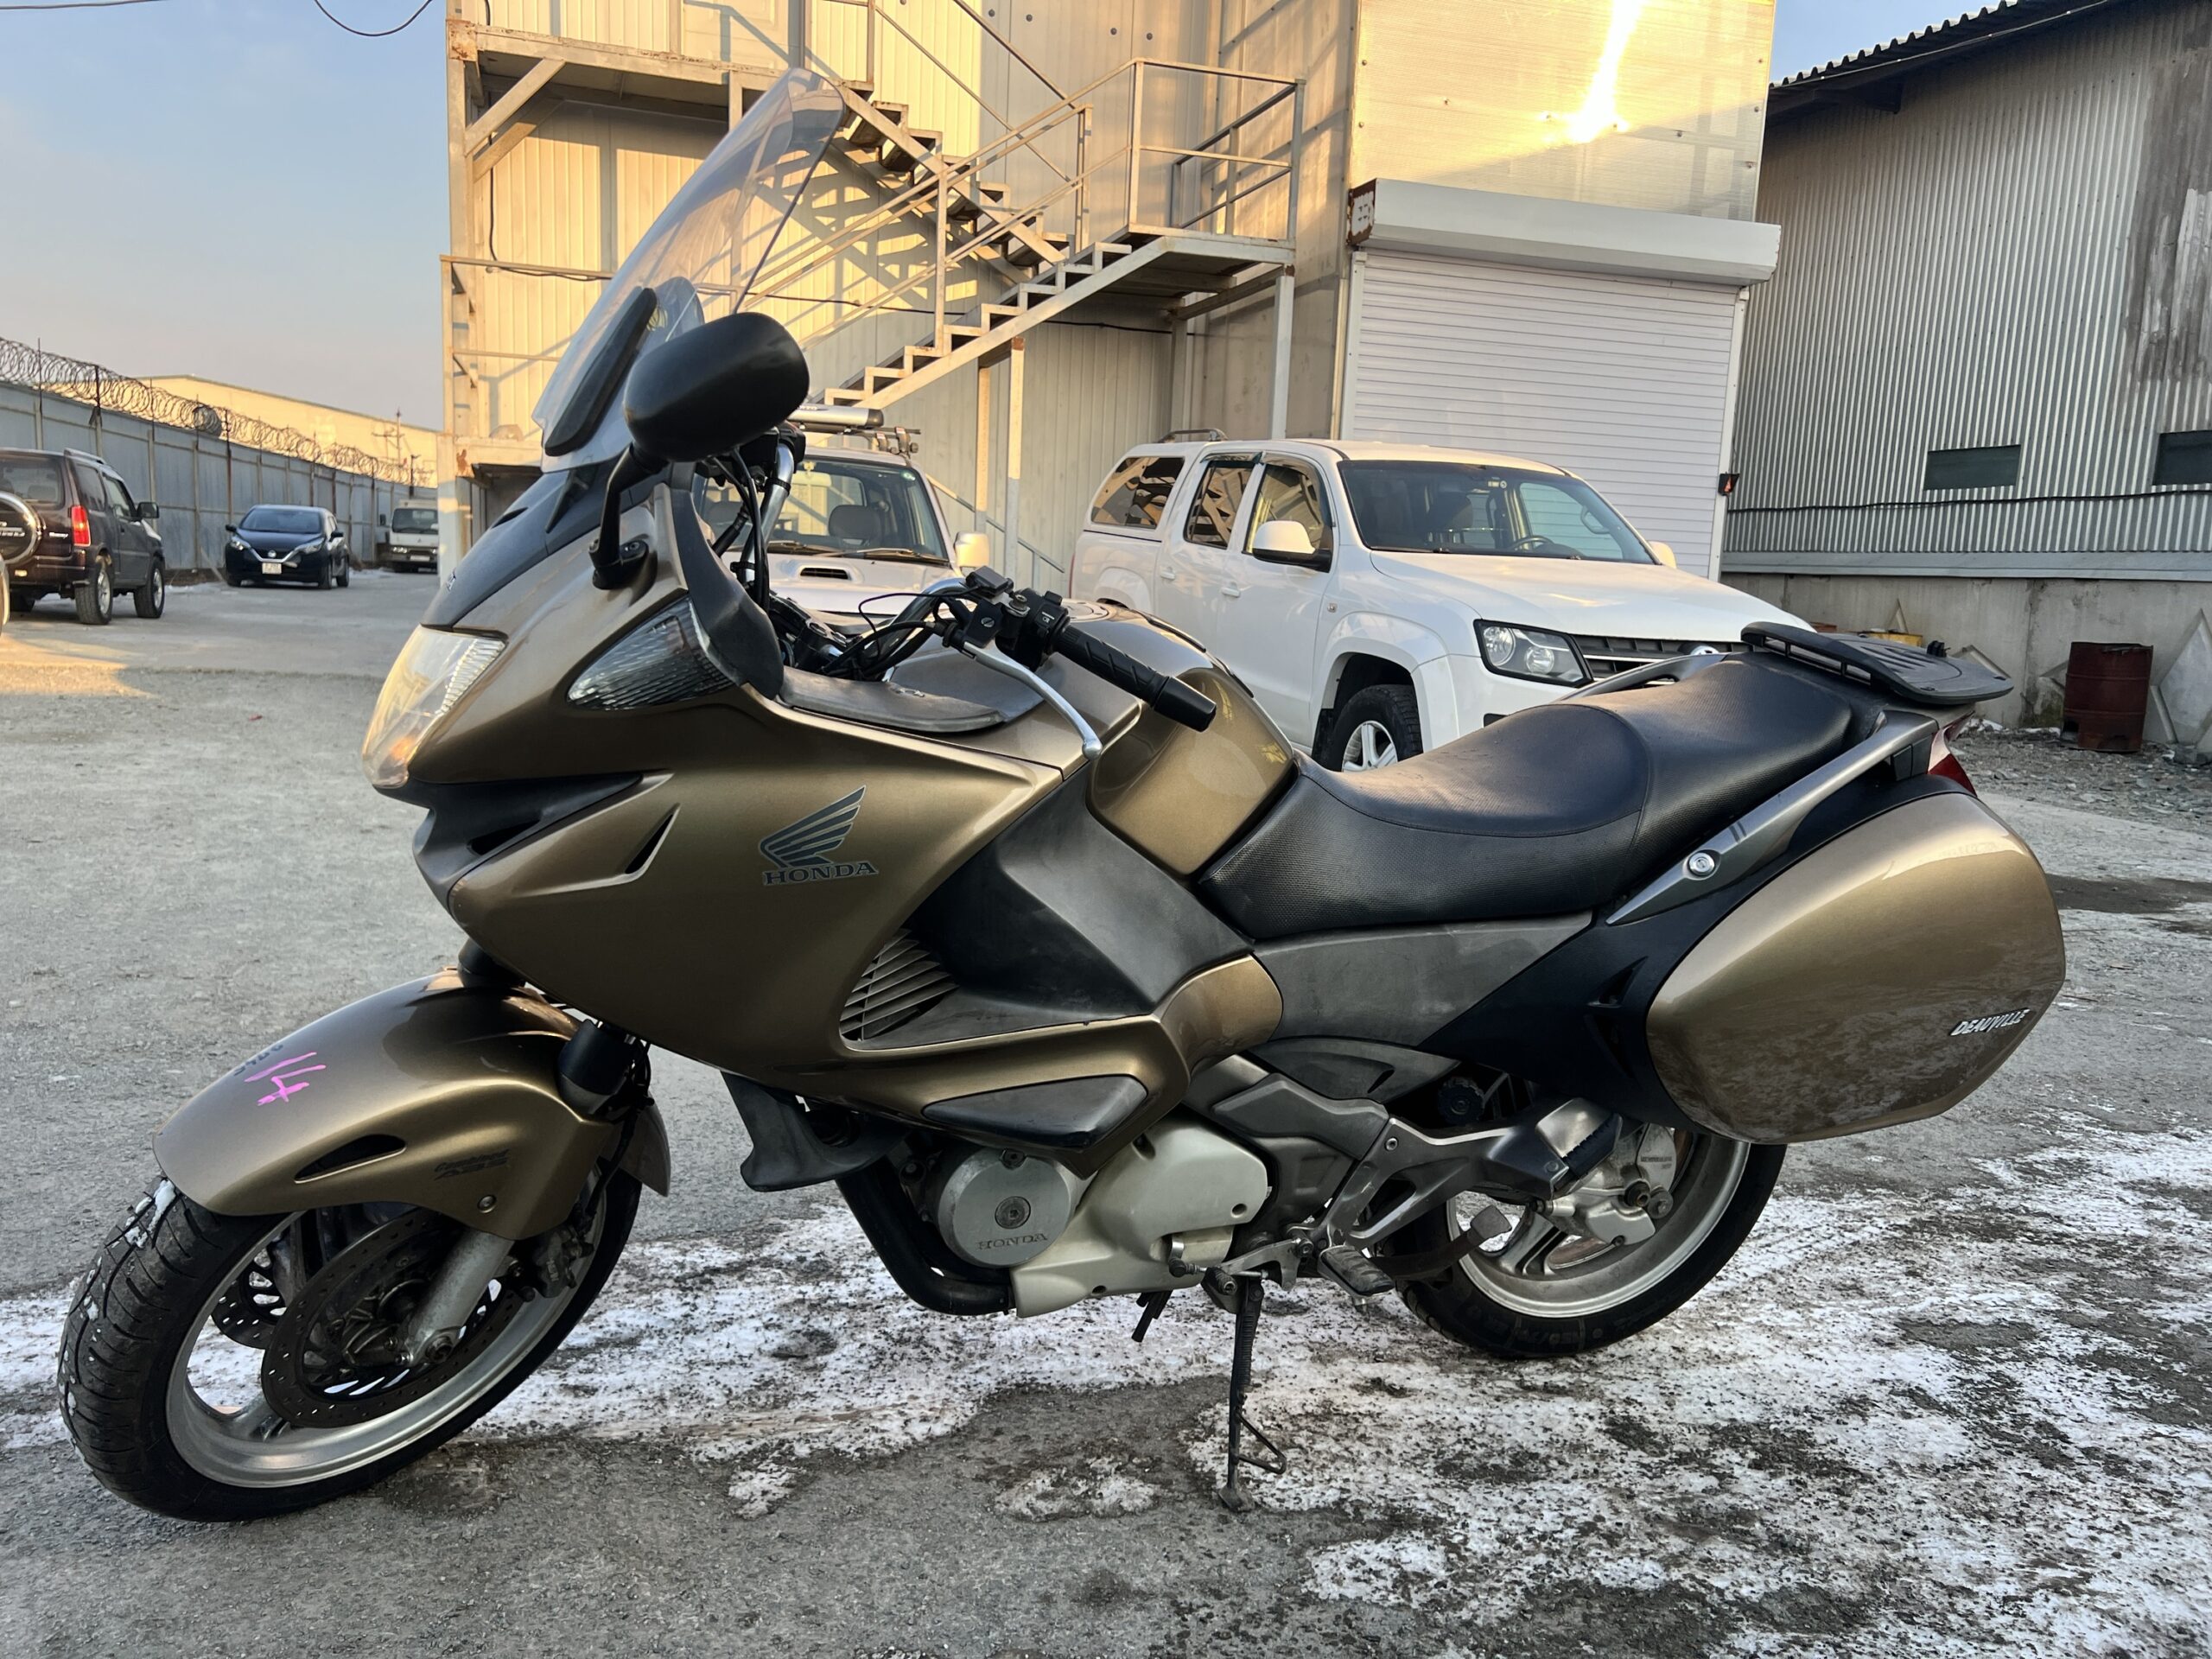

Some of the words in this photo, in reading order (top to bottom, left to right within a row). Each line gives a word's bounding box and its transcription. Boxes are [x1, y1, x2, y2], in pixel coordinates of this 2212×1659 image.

[763, 861, 878, 885] HONDA
[1949, 1007, 2031, 1037] DEAUVILLE
[976, 1233, 1048, 1249] HONDA
